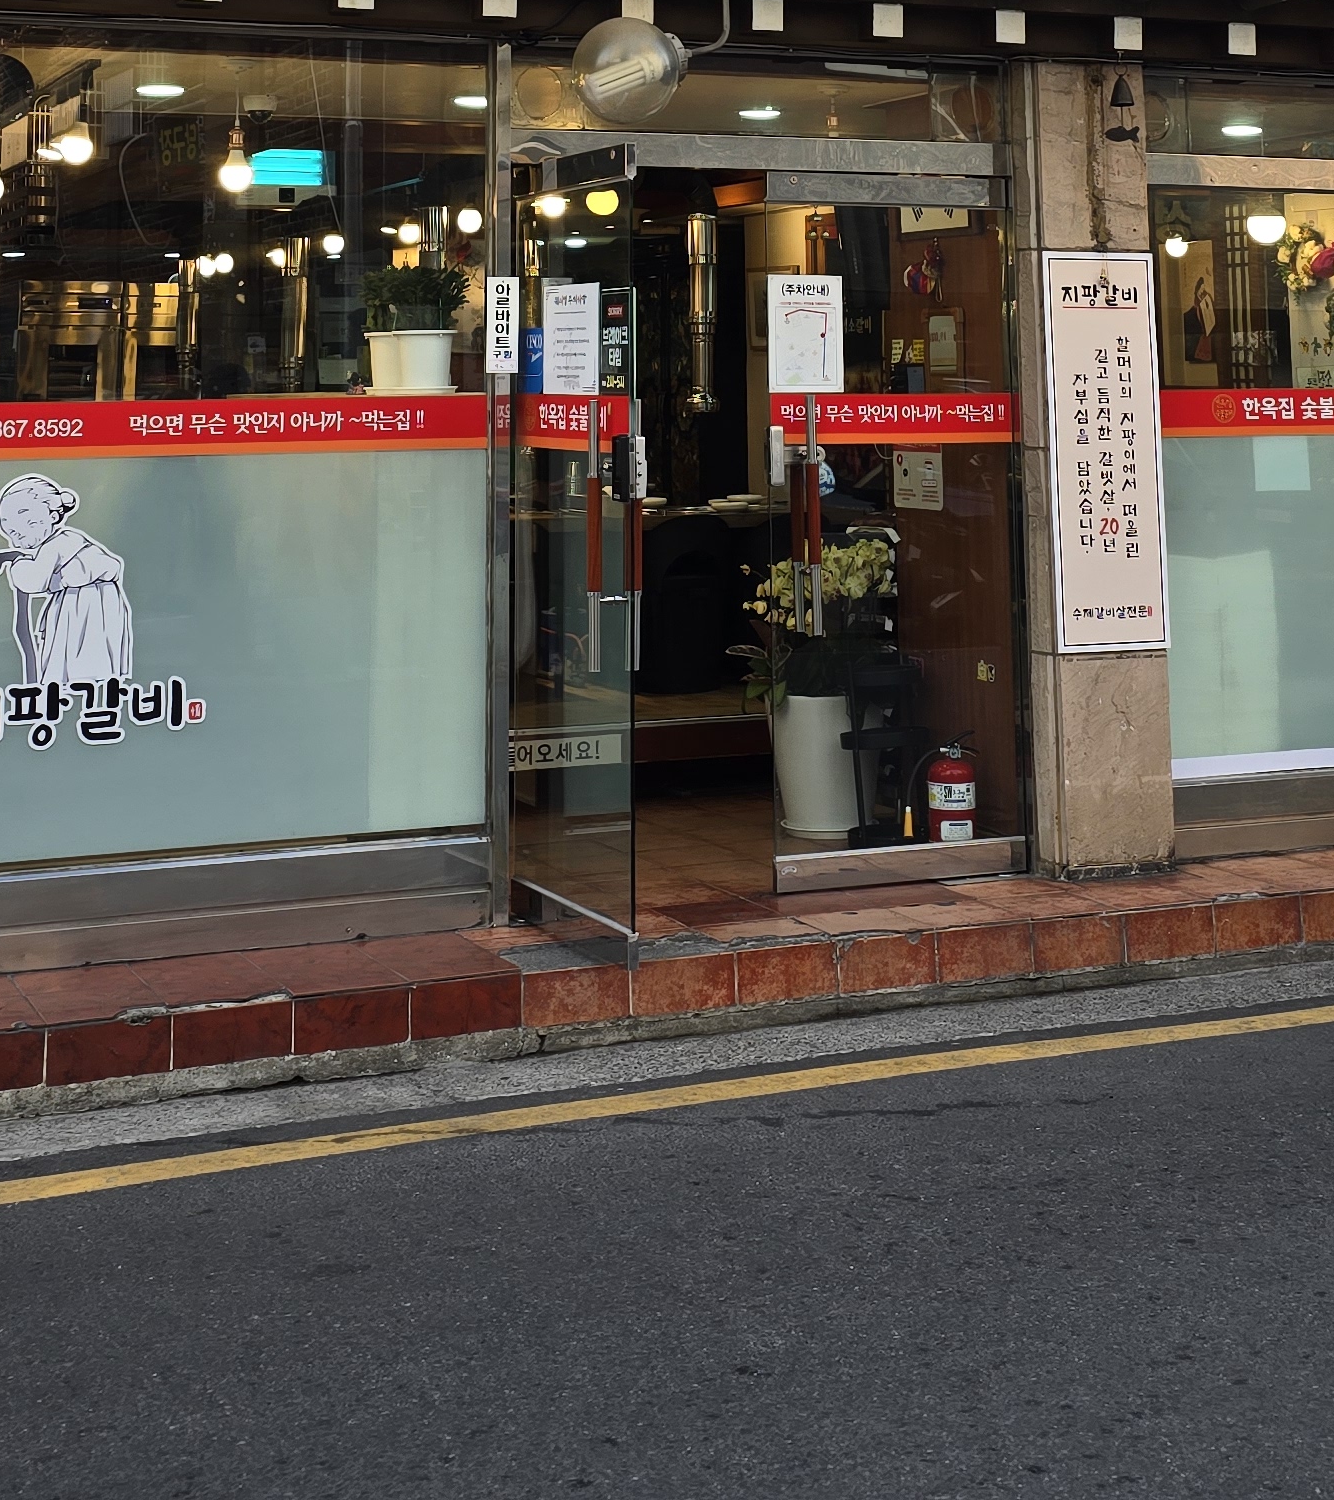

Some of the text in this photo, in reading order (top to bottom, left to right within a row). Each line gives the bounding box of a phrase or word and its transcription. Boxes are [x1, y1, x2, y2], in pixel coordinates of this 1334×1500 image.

[781, 282, 830, 296] (주차안내)
[1061, 284, 1138, 306] 지팡갈비
[495, 284, 511, 348] 아르바이트
[602, 325, 629, 346] 브레이크
[608, 348, 622, 367] 타임
[1094, 349, 1109, 379] 길고
[538, 403, 607, 432] 한옥집 숯불비
[825, 405, 854, 422] 무슨
[858, 404, 898, 422] 맛인지
[902, 404, 943, 422] 아니까
[1072, 373, 1090, 445] 자부심을
[1096, 388, 1112, 441] 듬직한
[1242, 397, 1295, 420] 한옥집
[129, 413, 184, 436] 먹으면
[188, 413, 227, 436] 무슨
[233, 411, 285, 434] 맛인지
[290, 410, 344, 433] 아니까
[1116, 336, 1139, 558] 할머니의 지팡이에서 떠올린
[1072, 605, 1148, 621] 수제갈비살전문
[509, 740, 600, 767] 어오세요!
